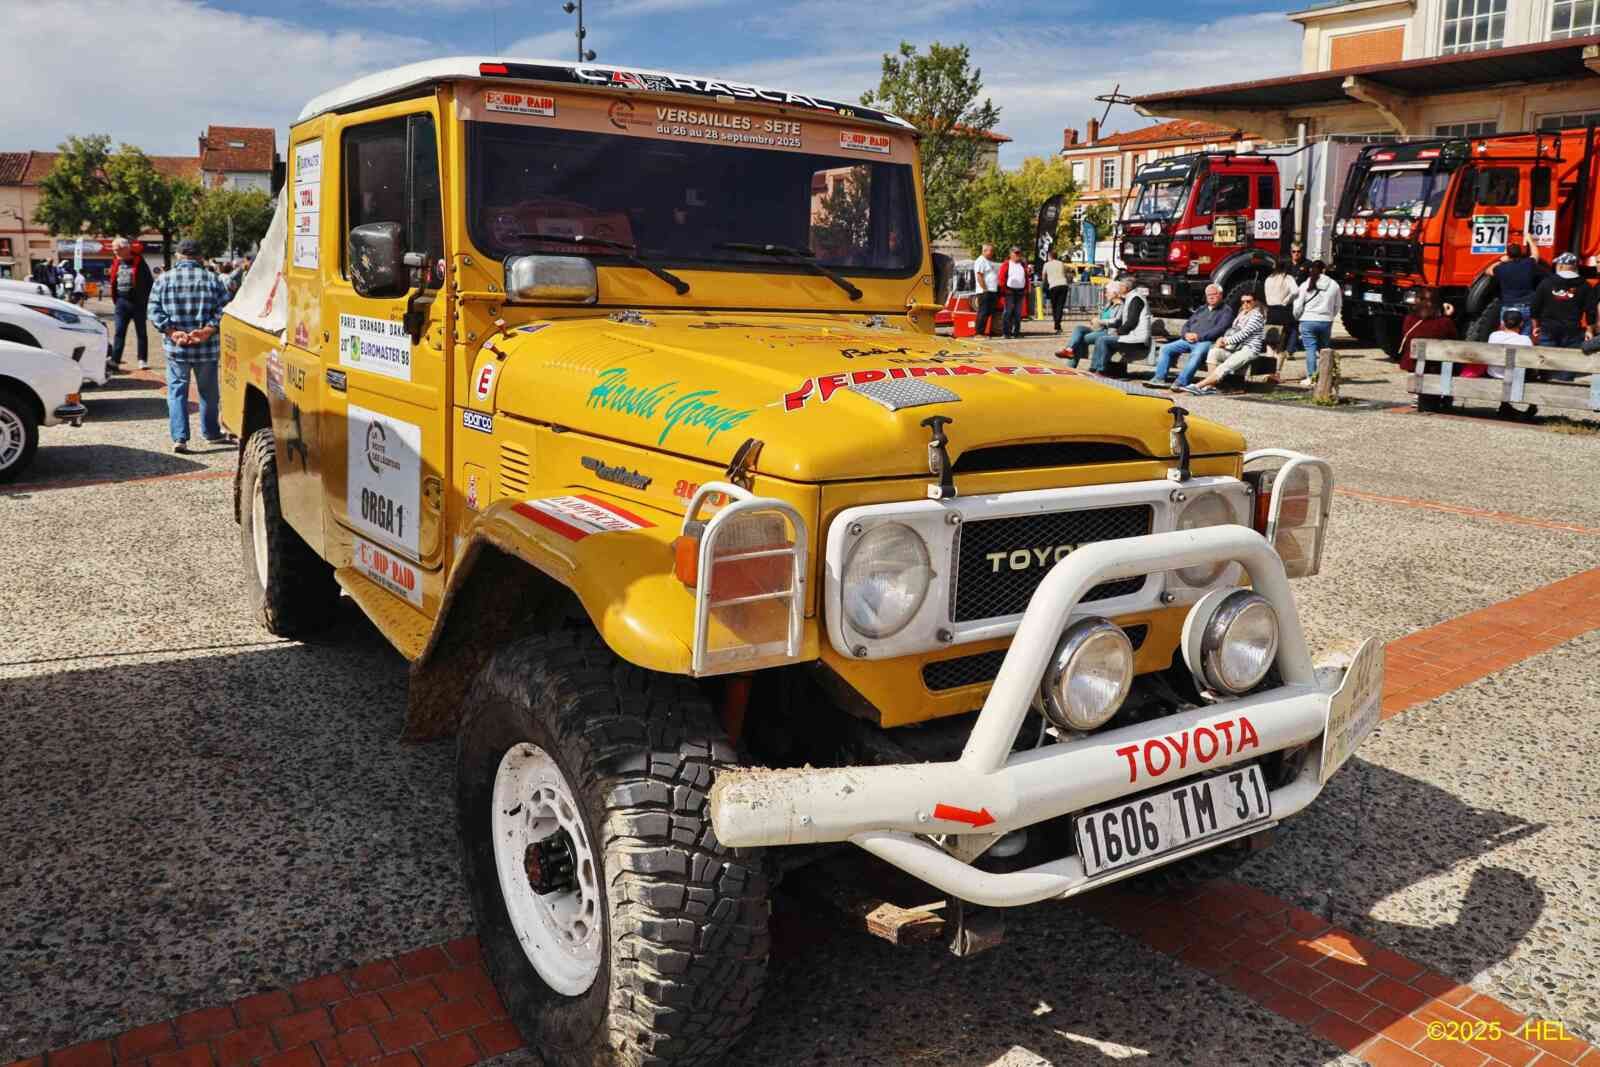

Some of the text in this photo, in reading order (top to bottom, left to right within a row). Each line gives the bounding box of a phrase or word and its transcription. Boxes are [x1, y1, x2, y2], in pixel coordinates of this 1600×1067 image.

[656, 107, 751, 129] VERSAILLES
[764, 120, 801, 134] SETE
[656, 126, 670, 134] du
[672, 126, 687, 136] 26
[705, 129, 718, 139] 28
[721, 132, 774, 145] septembre
[777, 136, 801, 147] 2025
[1257, 220, 1278, 231] 300
[1475, 226, 1506, 244] 571
[1530, 224, 1551, 236] 01
[360, 319, 385, 333] GRANADA
[389, 323, 408, 336] DAKA
[360, 341, 400, 362] EUROMASTER
[401, 350, 409, 366] 98
[478, 368, 492, 394] E
[463, 411, 492, 430] sparco
[361, 487, 393, 534] ORGA
[986, 545, 1076, 573] TOYO
[1116, 717, 1259, 783] TOYOTA
[1084, 767, 1266, 868] 1606 TM 31
